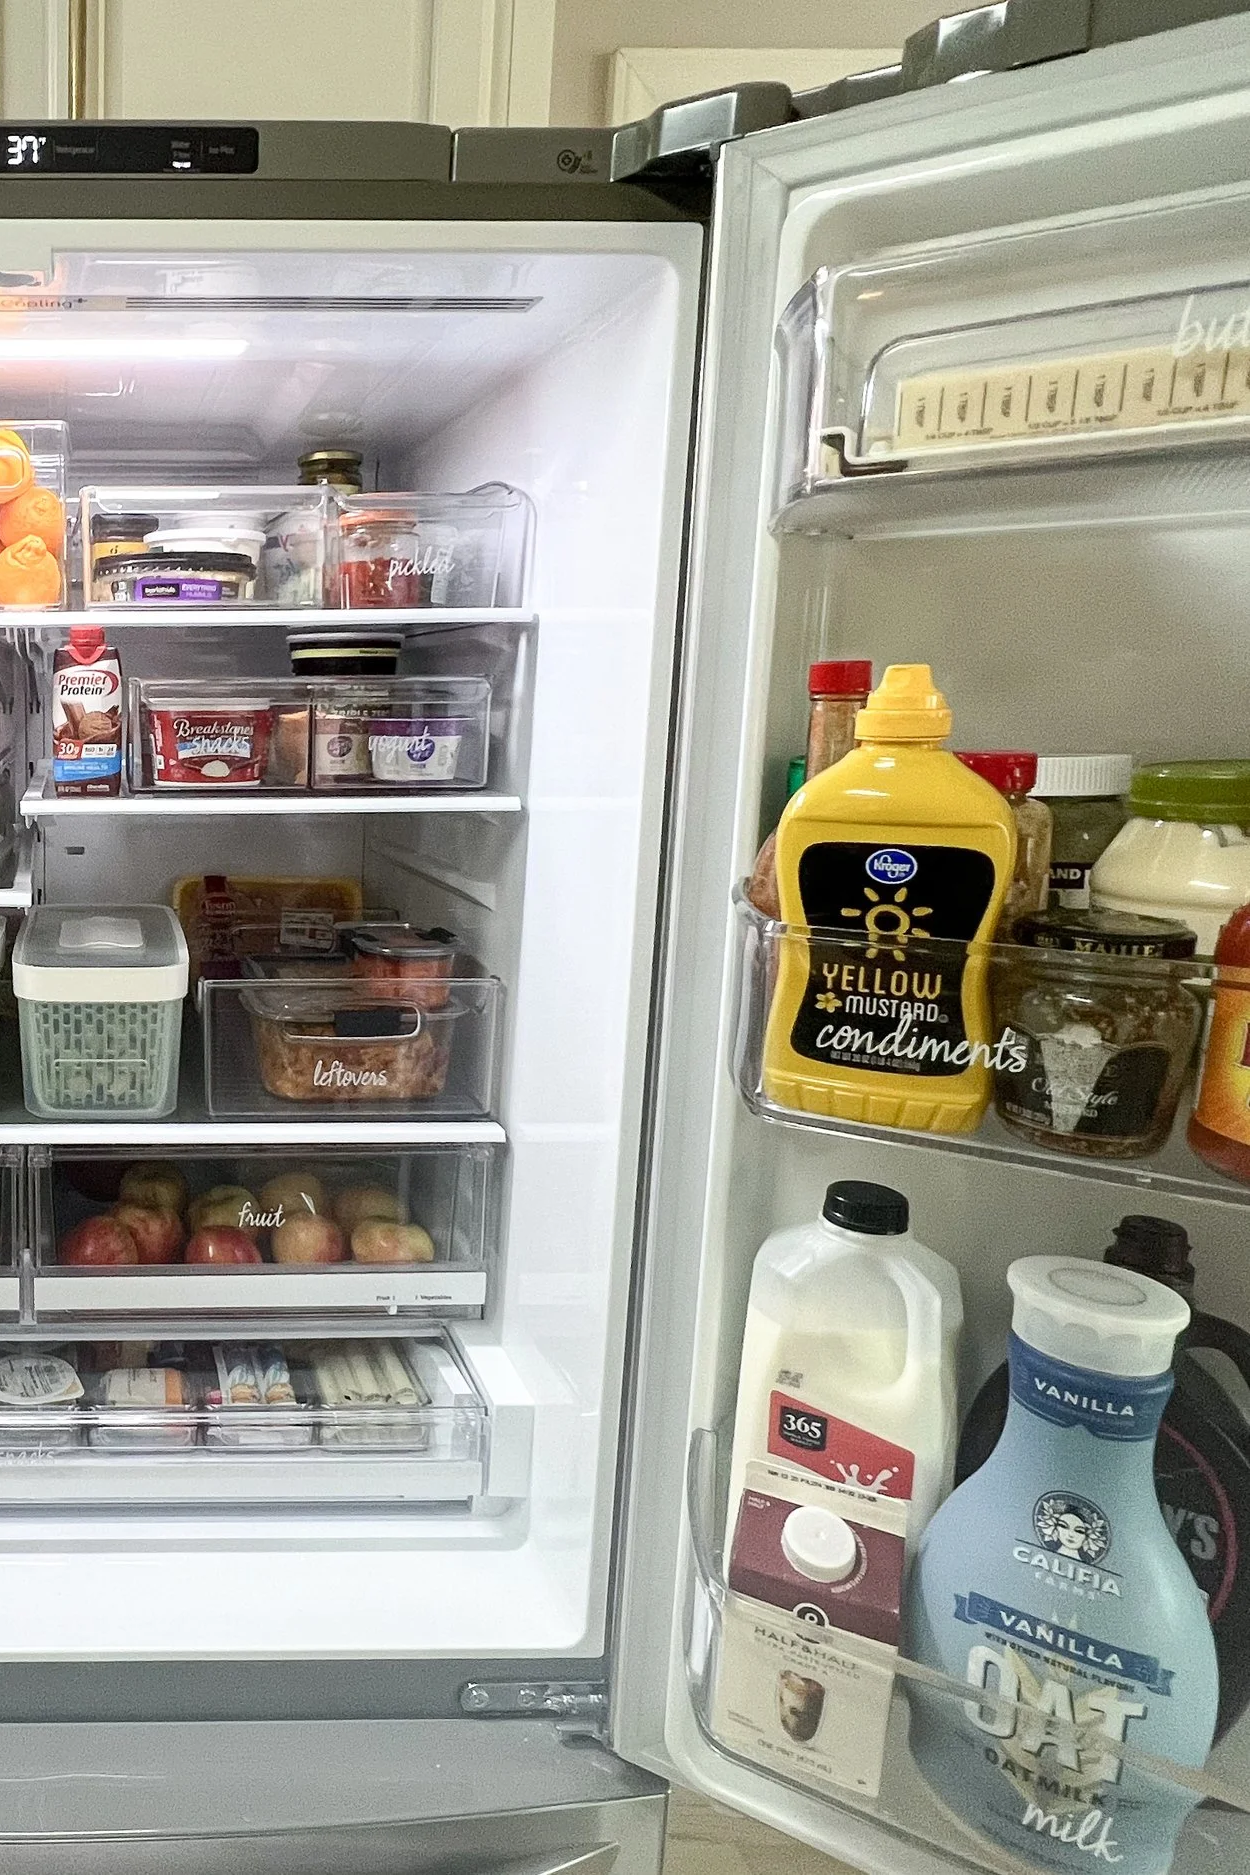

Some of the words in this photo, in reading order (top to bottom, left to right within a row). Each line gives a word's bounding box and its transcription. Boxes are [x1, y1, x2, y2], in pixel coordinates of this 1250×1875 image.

[387, 545, 456, 591] pickled
[58, 673, 108, 686] Premier
[60, 684, 103, 696] Protein
[58, 742, 80, 755] 30g
[191, 727, 251, 755] snacks
[873, 854, 911, 879] Kroger
[821, 962, 943, 1000] YELLOW
[845, 995, 939, 1023] MUSTARD
[815, 1010, 1028, 1074] condiments
[313, 1059, 388, 1088] leftovers
[238, 1202, 286, 1229] fruit
[1033, 1377, 1135, 1418] VANILLA
[783, 1413, 822, 1439] 365
[1012, 1545, 1123, 1598] CALIFIA
[754, 1626, 797, 1648] HALF
[999, 1609, 1124, 1671] VANILLA
[963, 1645, 1149, 1786] OAT
[1021, 1803, 1124, 1863] milk
